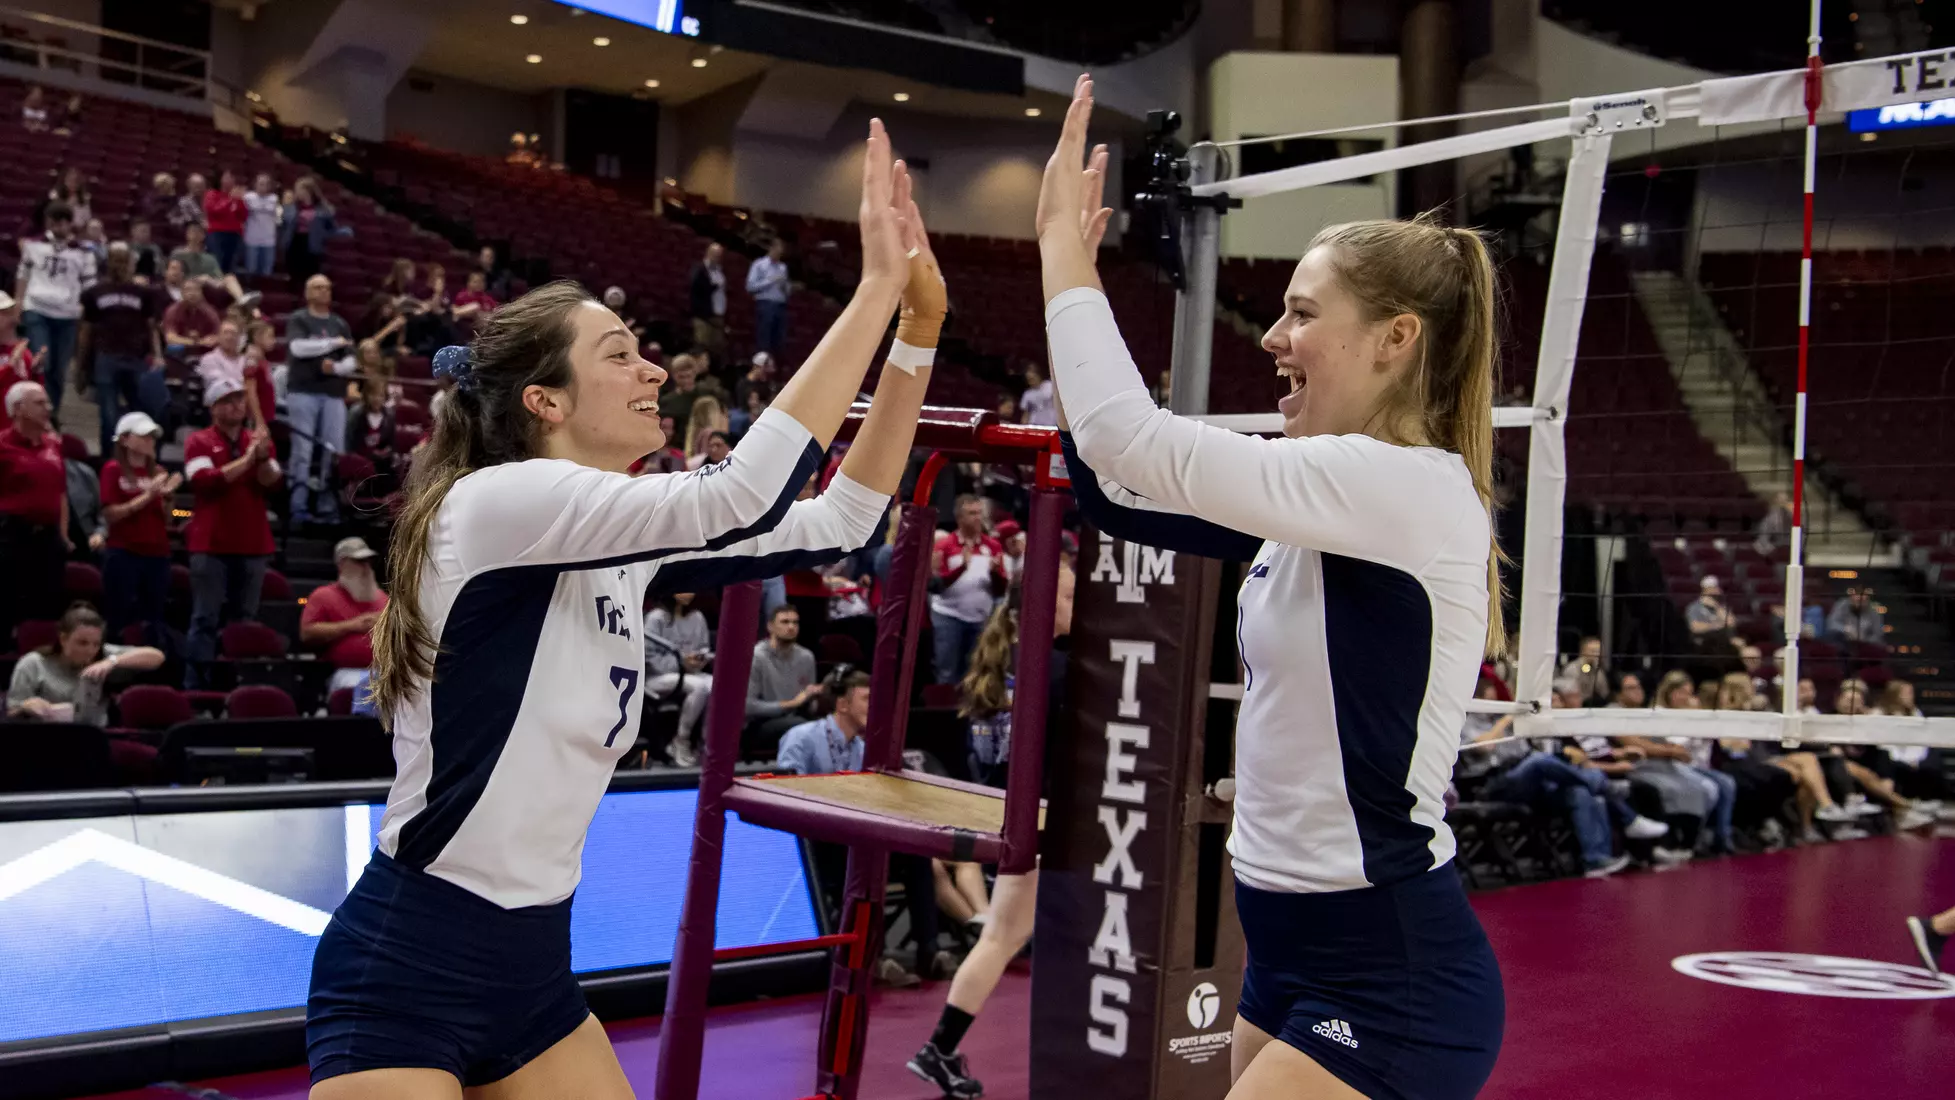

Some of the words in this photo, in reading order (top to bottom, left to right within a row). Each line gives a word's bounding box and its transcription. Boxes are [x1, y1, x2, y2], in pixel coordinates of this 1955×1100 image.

[1885, 51, 1955, 95] TE
[603, 665, 639, 749] 7
[1087, 638, 1156, 1058] TEXAS
[1168, 1036, 1199, 1052] SPORTS
[1312, 1024, 1359, 1049] adidas
